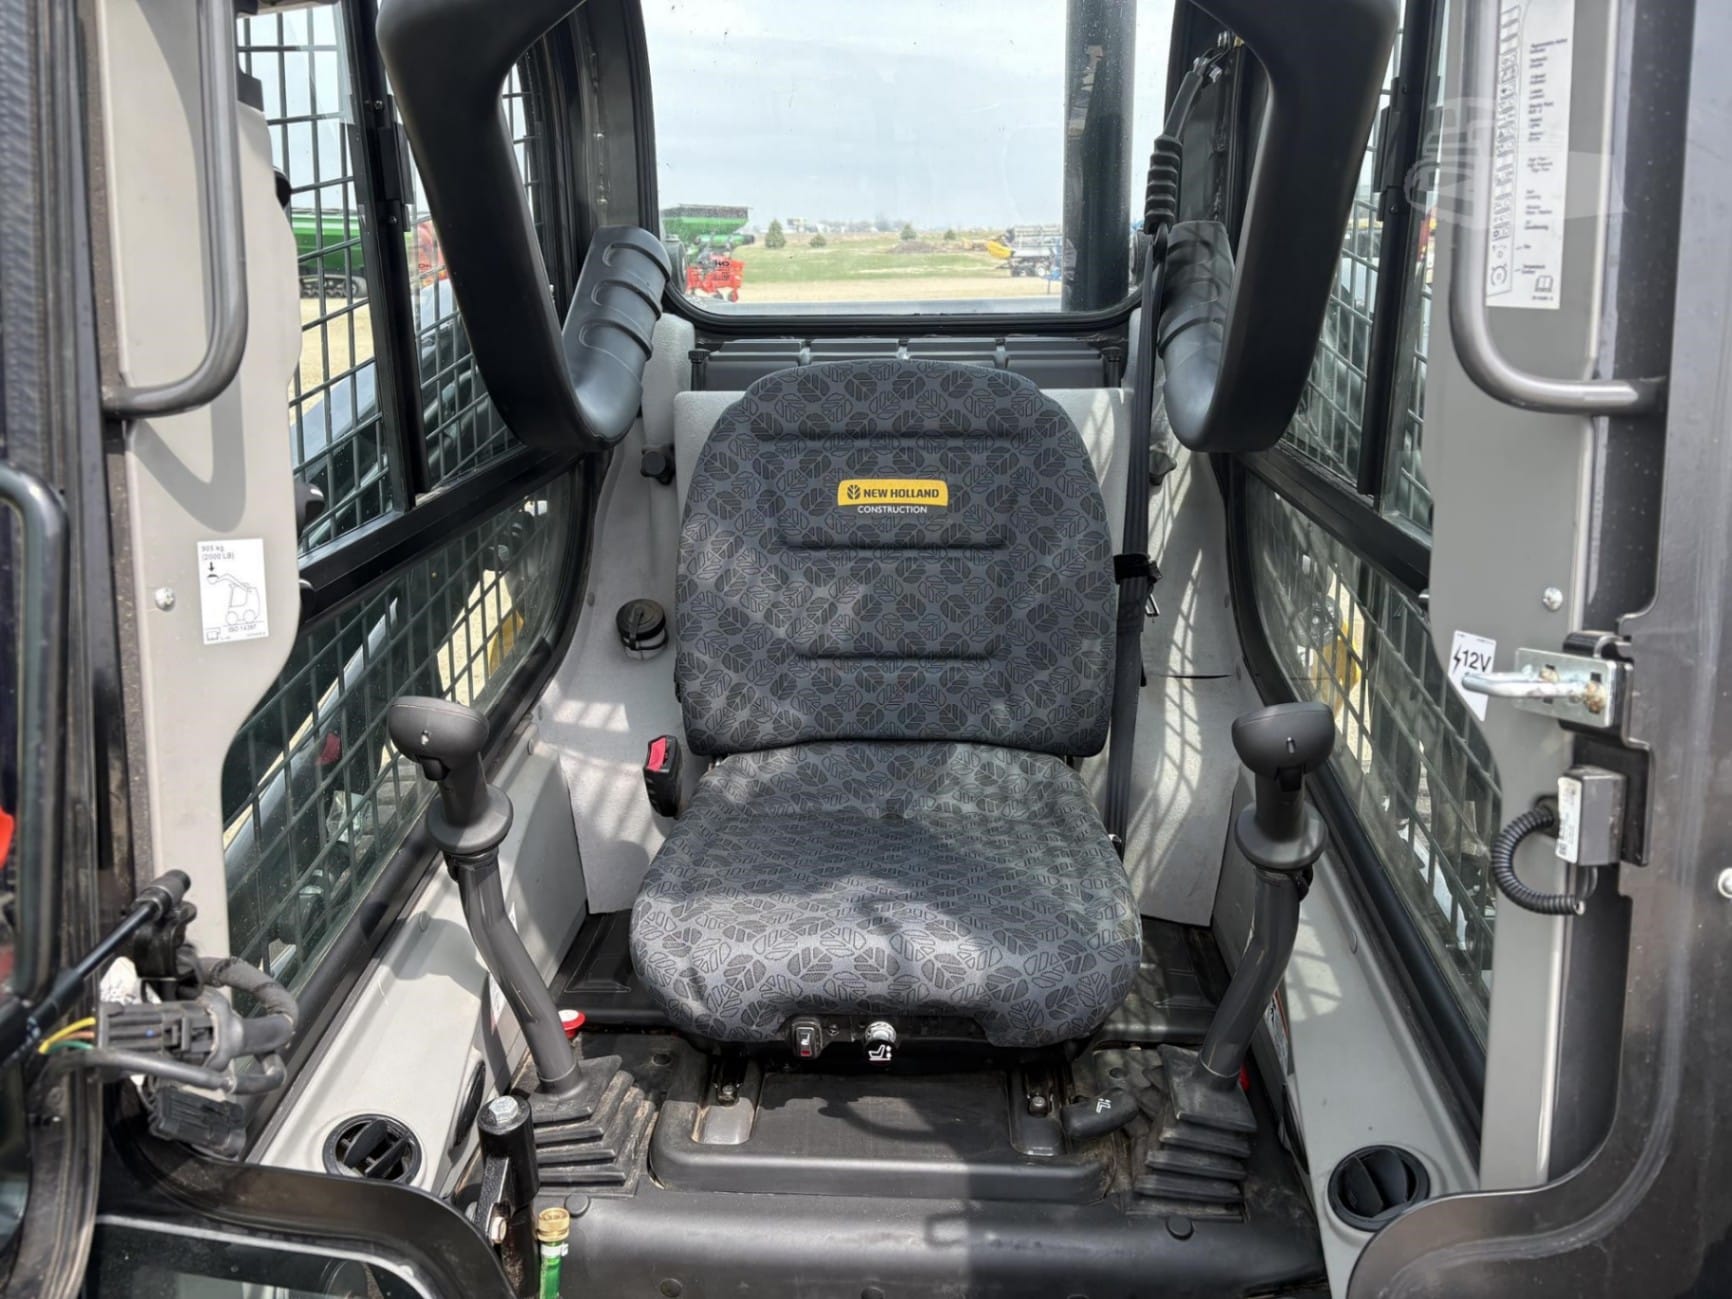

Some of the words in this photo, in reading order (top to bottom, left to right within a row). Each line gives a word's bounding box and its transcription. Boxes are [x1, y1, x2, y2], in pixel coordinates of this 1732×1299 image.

[863, 489, 888, 498] NEW
[891, 489, 939, 498] HOLLAND
[857, 506, 928, 514] CONSTRUCTION
[1462, 650, 1492, 672] 12V
